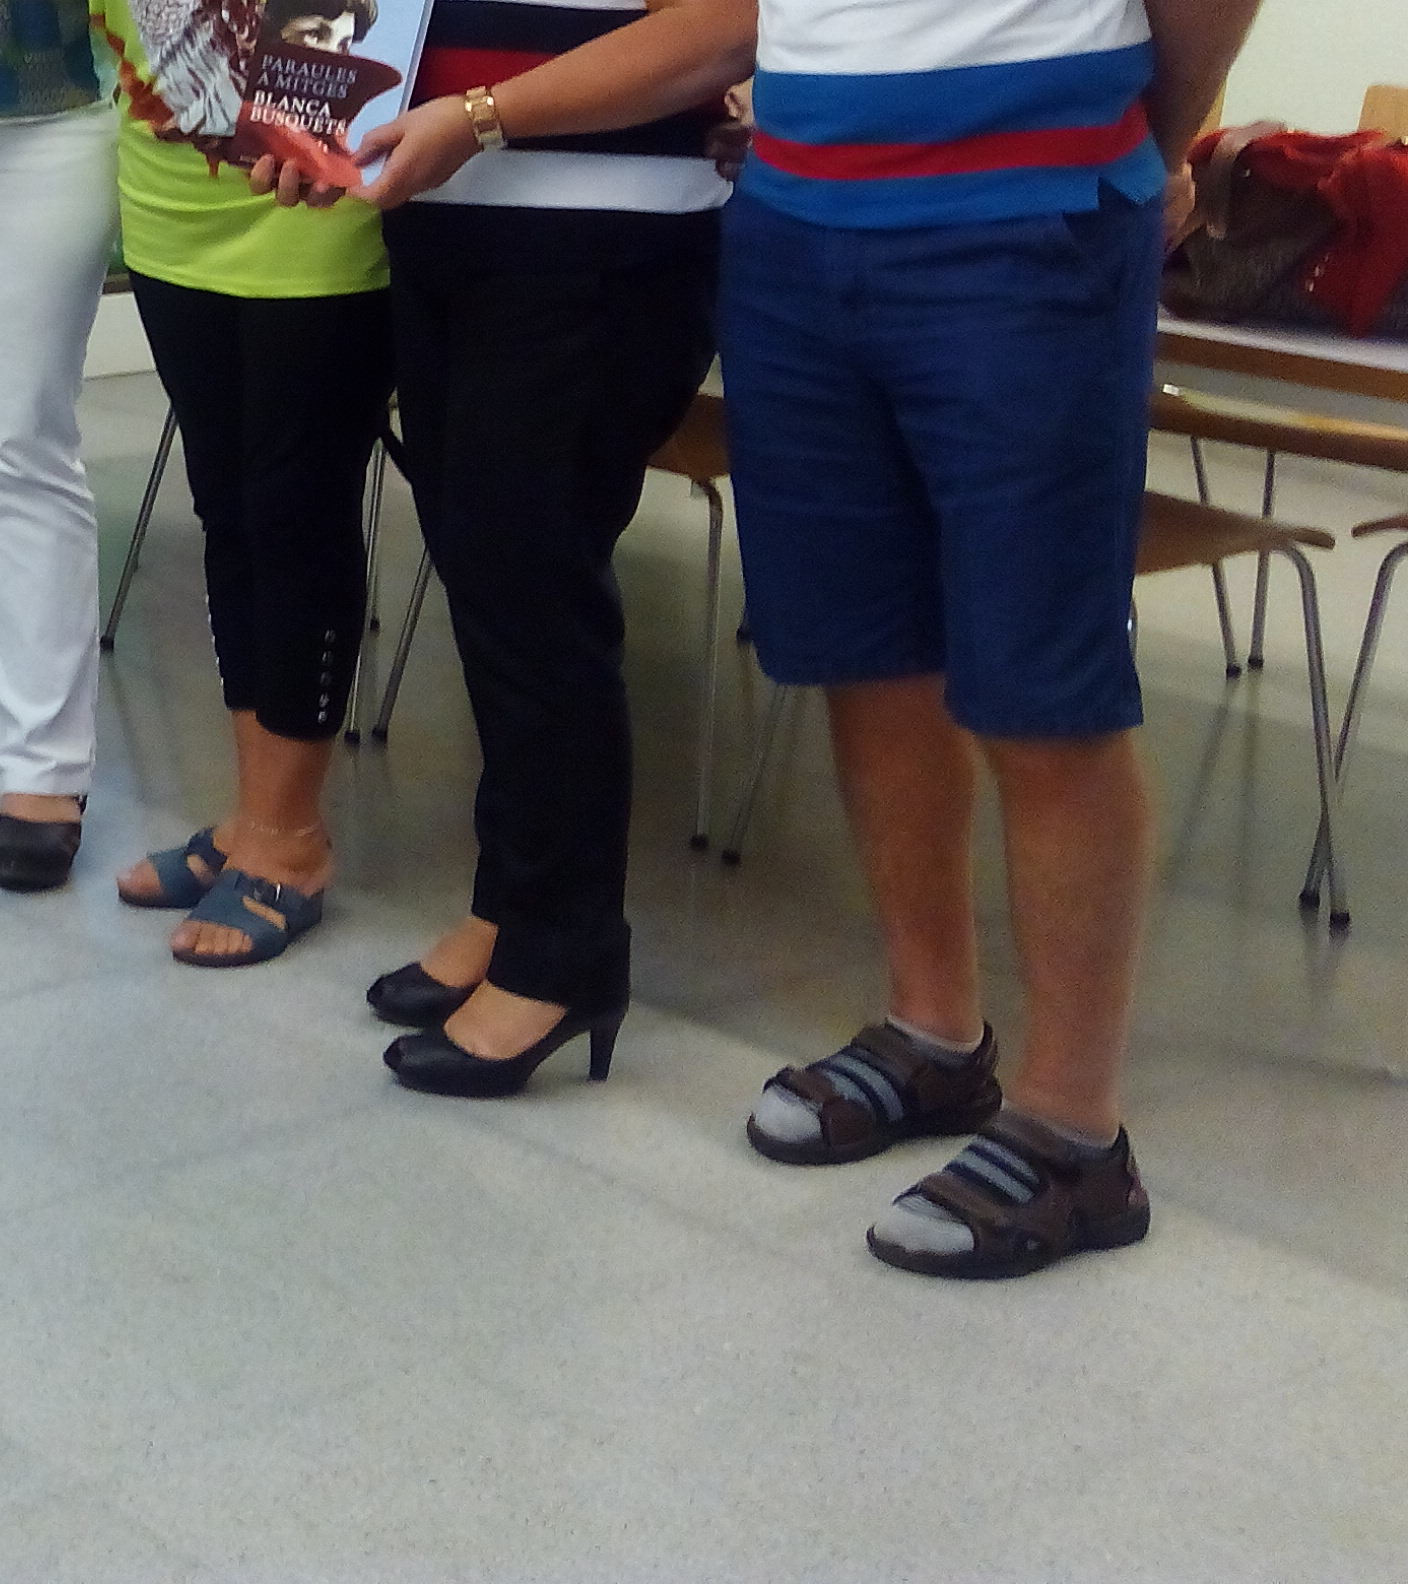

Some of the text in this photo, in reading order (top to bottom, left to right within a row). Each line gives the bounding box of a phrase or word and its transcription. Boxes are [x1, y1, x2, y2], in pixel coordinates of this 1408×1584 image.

[262, 54, 359, 85] PARAULES
[256, 71, 349, 99] A MITGES
[252, 89, 332, 118] BLANCA
[249, 105, 347, 137] BUSQUETS
